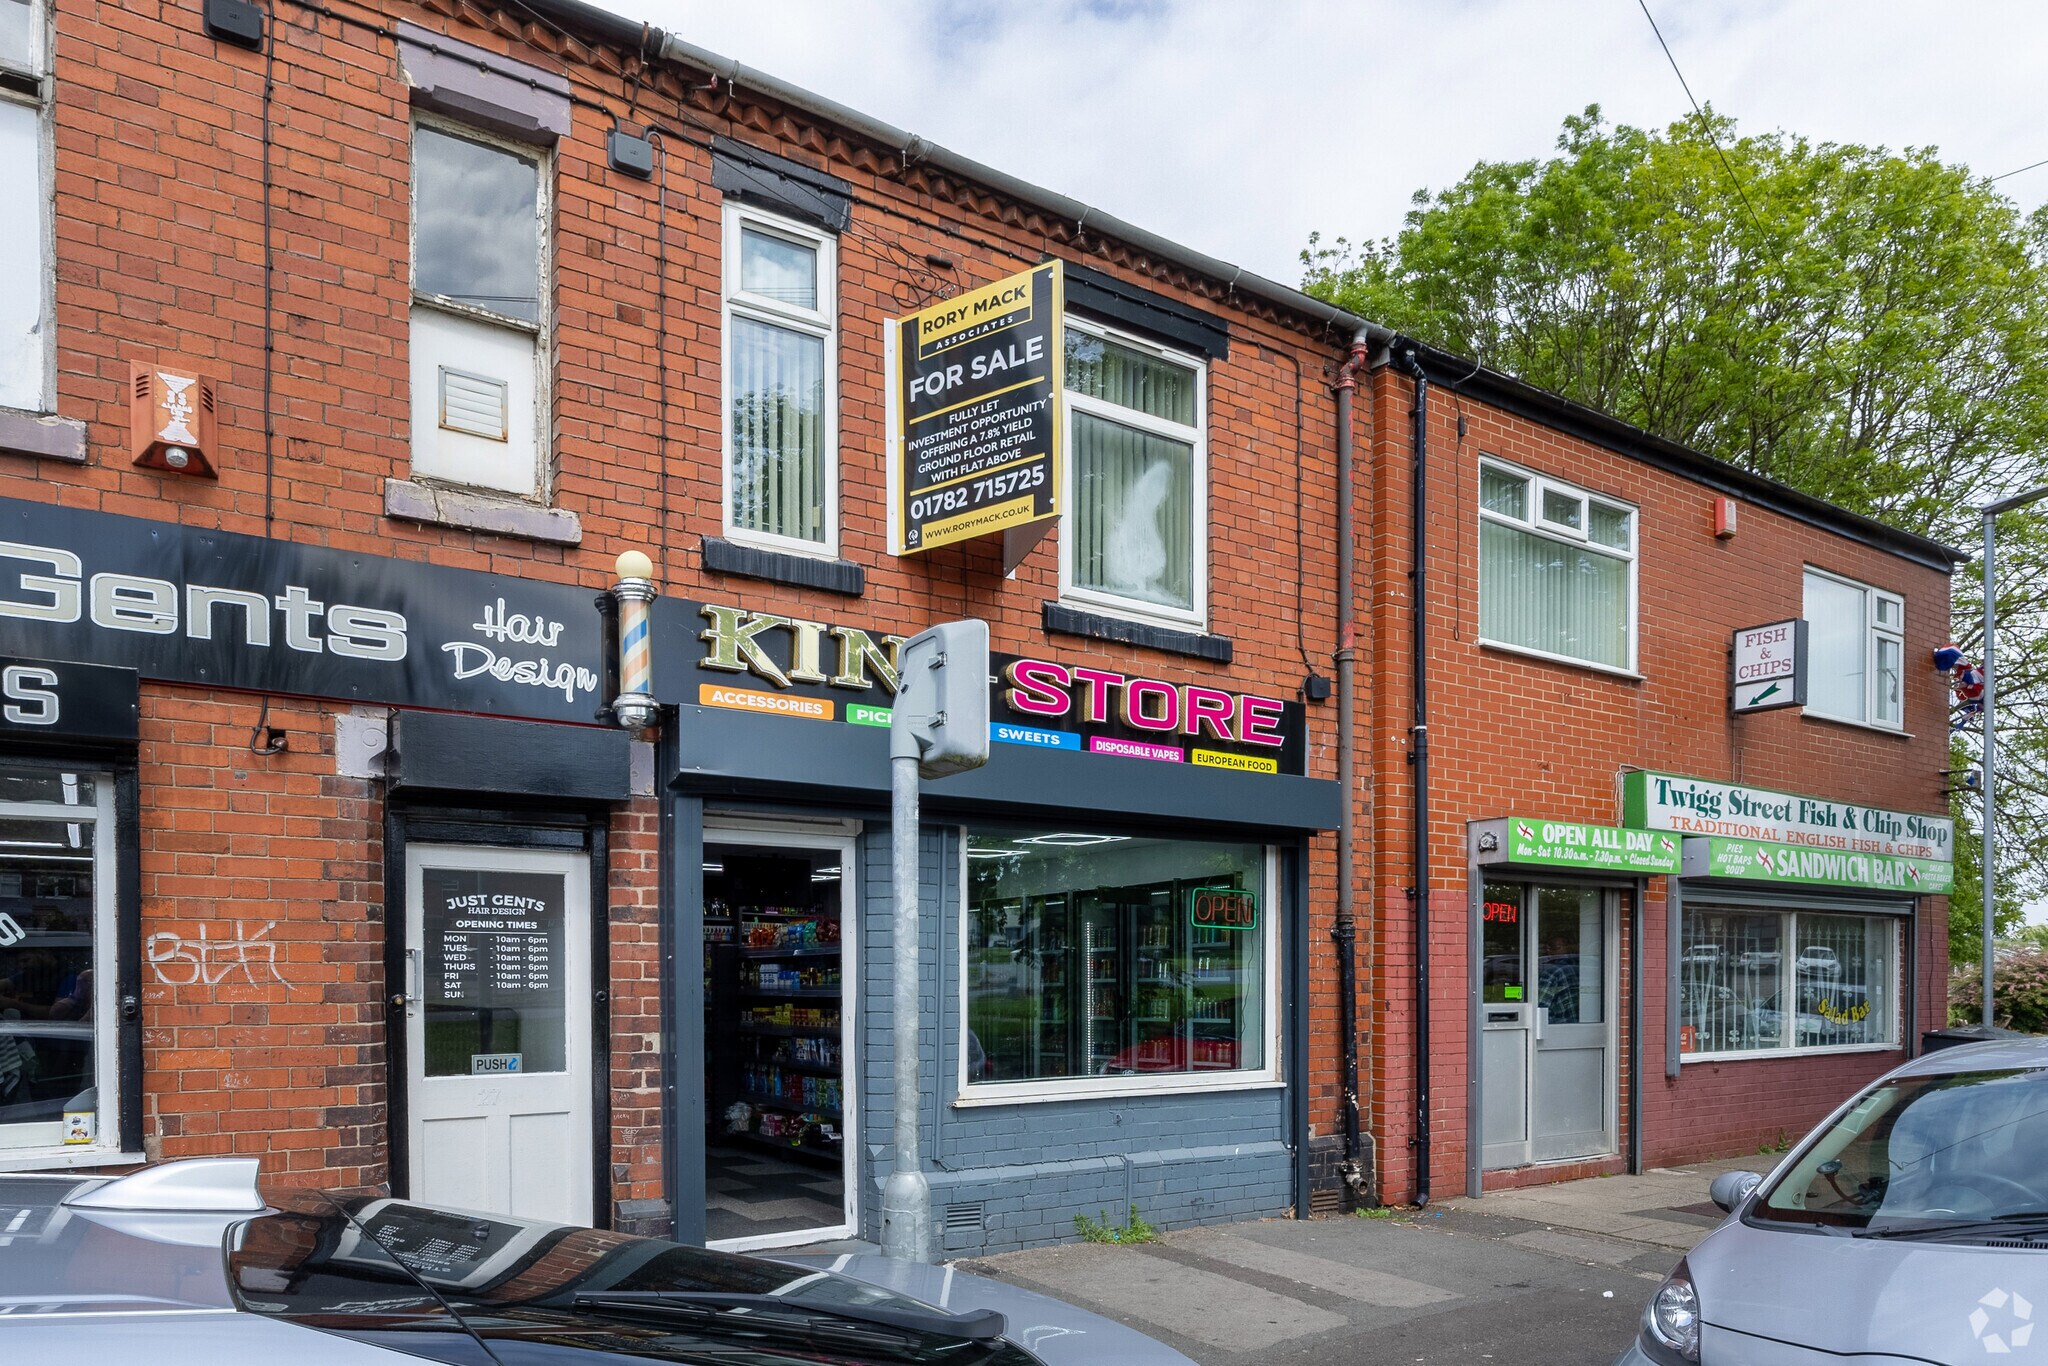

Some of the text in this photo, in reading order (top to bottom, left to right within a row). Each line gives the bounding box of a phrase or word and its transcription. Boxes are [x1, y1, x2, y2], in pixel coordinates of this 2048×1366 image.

[923, 285, 1027, 335] RORY MACK
[936, 315, 1014, 350] ASSOCIATES
[910, 335, 1044, 403] FOR SALE
[949, 399, 1000, 425] FULLY LET
[908, 399, 1047, 451] INVESTMENT OPPORTUNITY
[920, 417, 1033, 460] OFFERING A 7.8% YIELD
[918, 432, 1036, 474] GROUND FLOOR RETAIL
[931, 448, 1021, 483] WITH FLAT ABOVE
[910, 464, 1045, 520] 01782 715725
[925, 505, 1030, 539] WWW.RORYMACK.CO.UK
[0, 541, 408, 662] Gents
[472, 597, 565, 647] Hair
[1745, 627, 1787, 648] FISH
[1760, 647, 1771, 659] &
[441, 642, 598, 703] Design
[700, 603, 1285, 747] KIN STORE
[1738, 658, 1792, 679] CHIPS
[711, 690, 823, 715] ACCESSORIES
[998, 727, 1060, 745] SWEETS
[1096, 740, 1180, 761] DISPOSABLE VAPES
[1197, 753, 1272, 771] EUROPEAN FOOD
[1655, 777, 1948, 847] Twigg Street Fish & Chip Shop
[1542, 823, 1654, 852] OPEN ALL DAY
[1670, 816, 1933, 857] TRADITIONAL ENGLISH FISH & CHIPS
[1726, 843, 1744, 854] PIES
[1629, 855, 1650, 866] Closed
[1650, 855, 1674, 870] Sunday
[1717, 853, 1752, 865] HOT BAPS
[1724, 865, 1745, 875] SOUP
[1776, 849, 1906, 886] SANDWICH BAR
[446, 894, 546, 912] JUST GENTS
[468, 907, 526, 916] HAIR DESIGN
[1195, 895, 1254, 924] OPEN
[1482, 902, 1517, 923] OPEN
[455, 920, 538, 929] OPENING TIMES
[444, 944, 468, 952] TUES
[528, 945, 548, 953] 6pm
[528, 936, 548, 944] 6pm
[528, 955, 548, 963] 6pm
[528, 964, 548, 972] 6pm
[476, 1059, 507, 1071] PUSH
